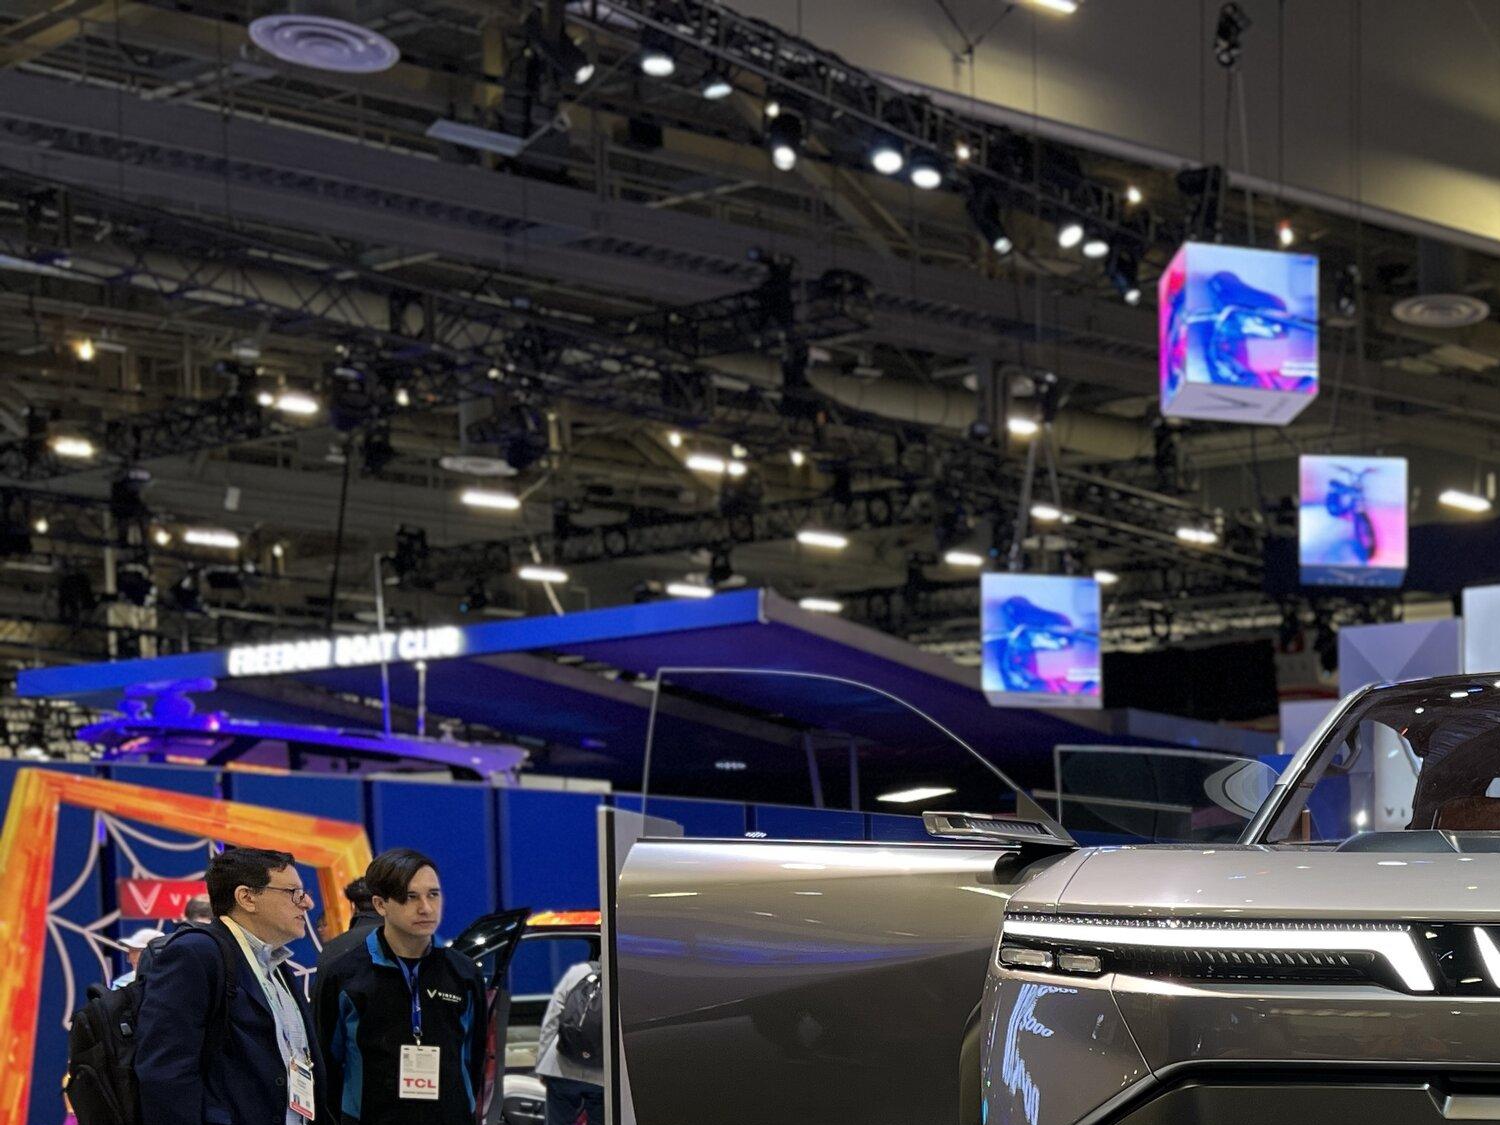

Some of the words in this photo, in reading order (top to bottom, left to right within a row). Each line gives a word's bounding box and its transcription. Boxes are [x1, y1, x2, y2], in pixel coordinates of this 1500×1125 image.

[334, 633, 396, 667] BOAT
[399, 626, 461, 660] CLUB
[403, 1077, 436, 1088] TCL
